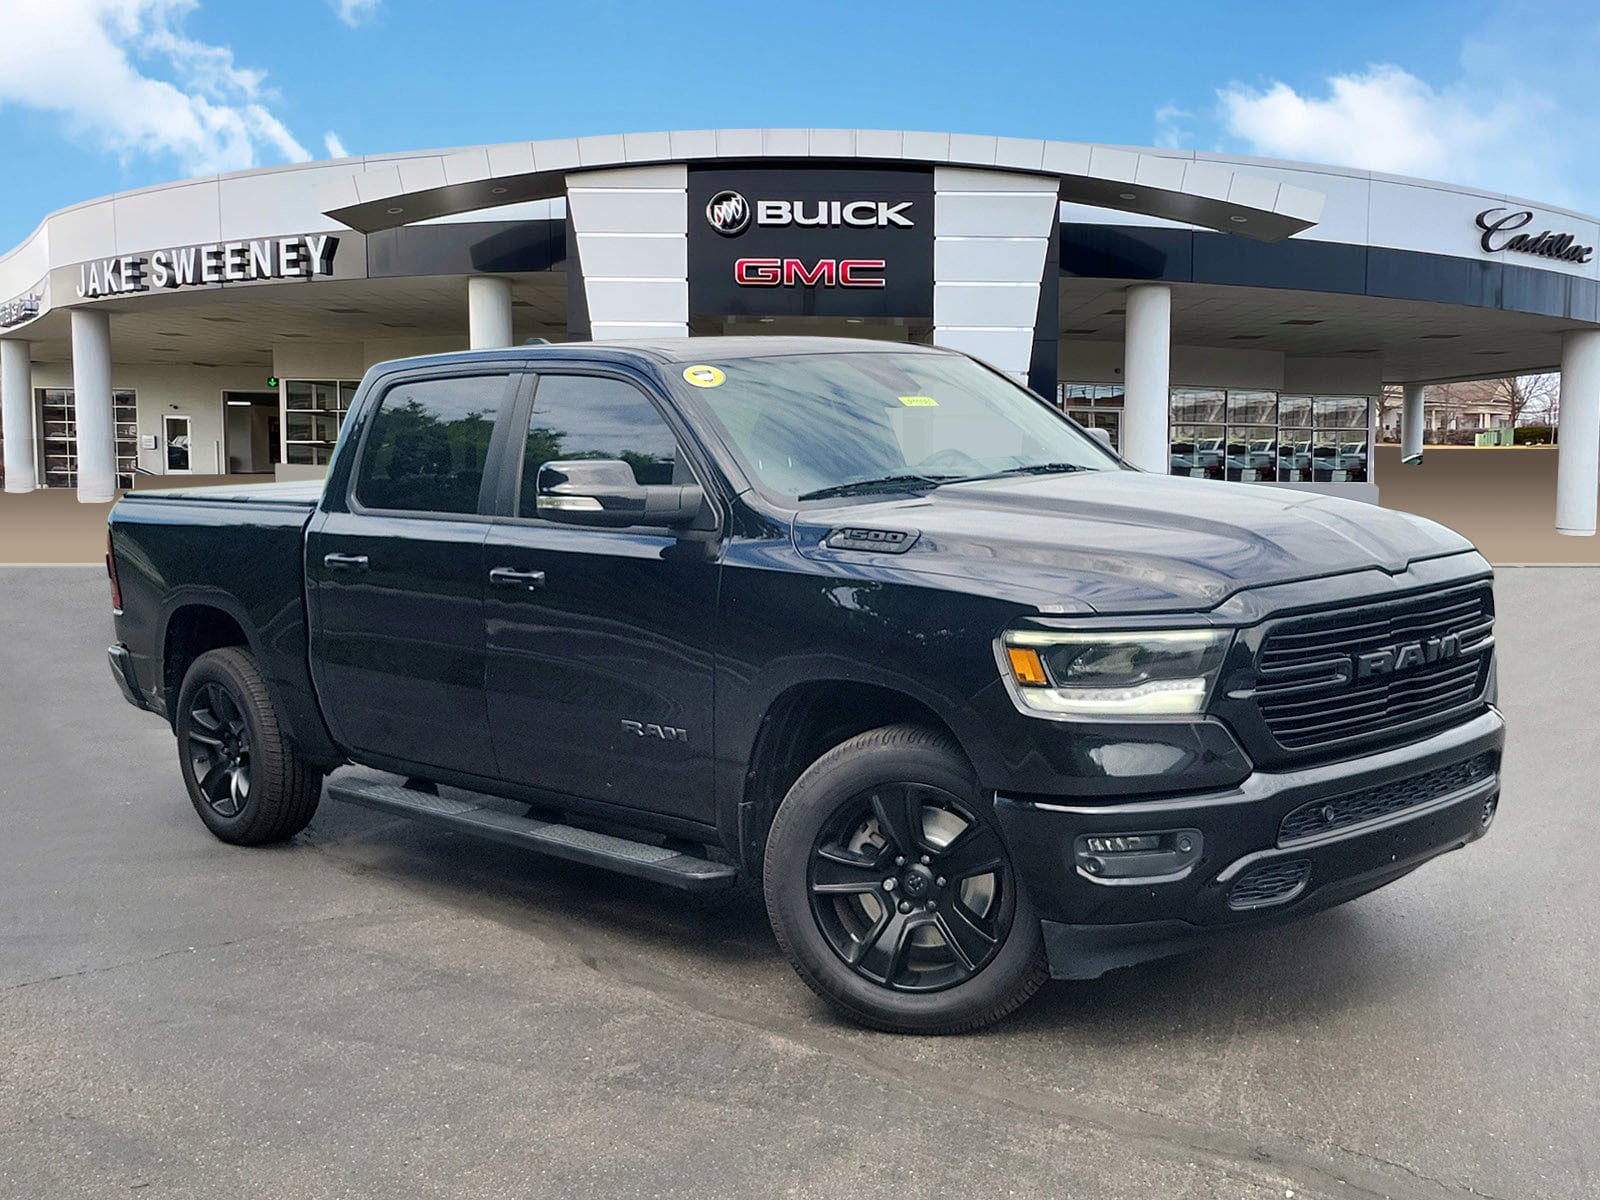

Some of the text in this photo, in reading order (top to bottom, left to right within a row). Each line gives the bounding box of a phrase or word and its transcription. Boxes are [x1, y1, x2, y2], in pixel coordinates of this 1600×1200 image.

[757, 200, 914, 226] BUICK
[1475, 207, 1593, 264] Cadillac
[76, 234, 336, 298] JAKE SWEENEY
[734, 258, 886, 287] GMC
[842, 528, 907, 543] 1500
[1357, 633, 1460, 678] RAM
[620, 719, 689, 742] RAM
